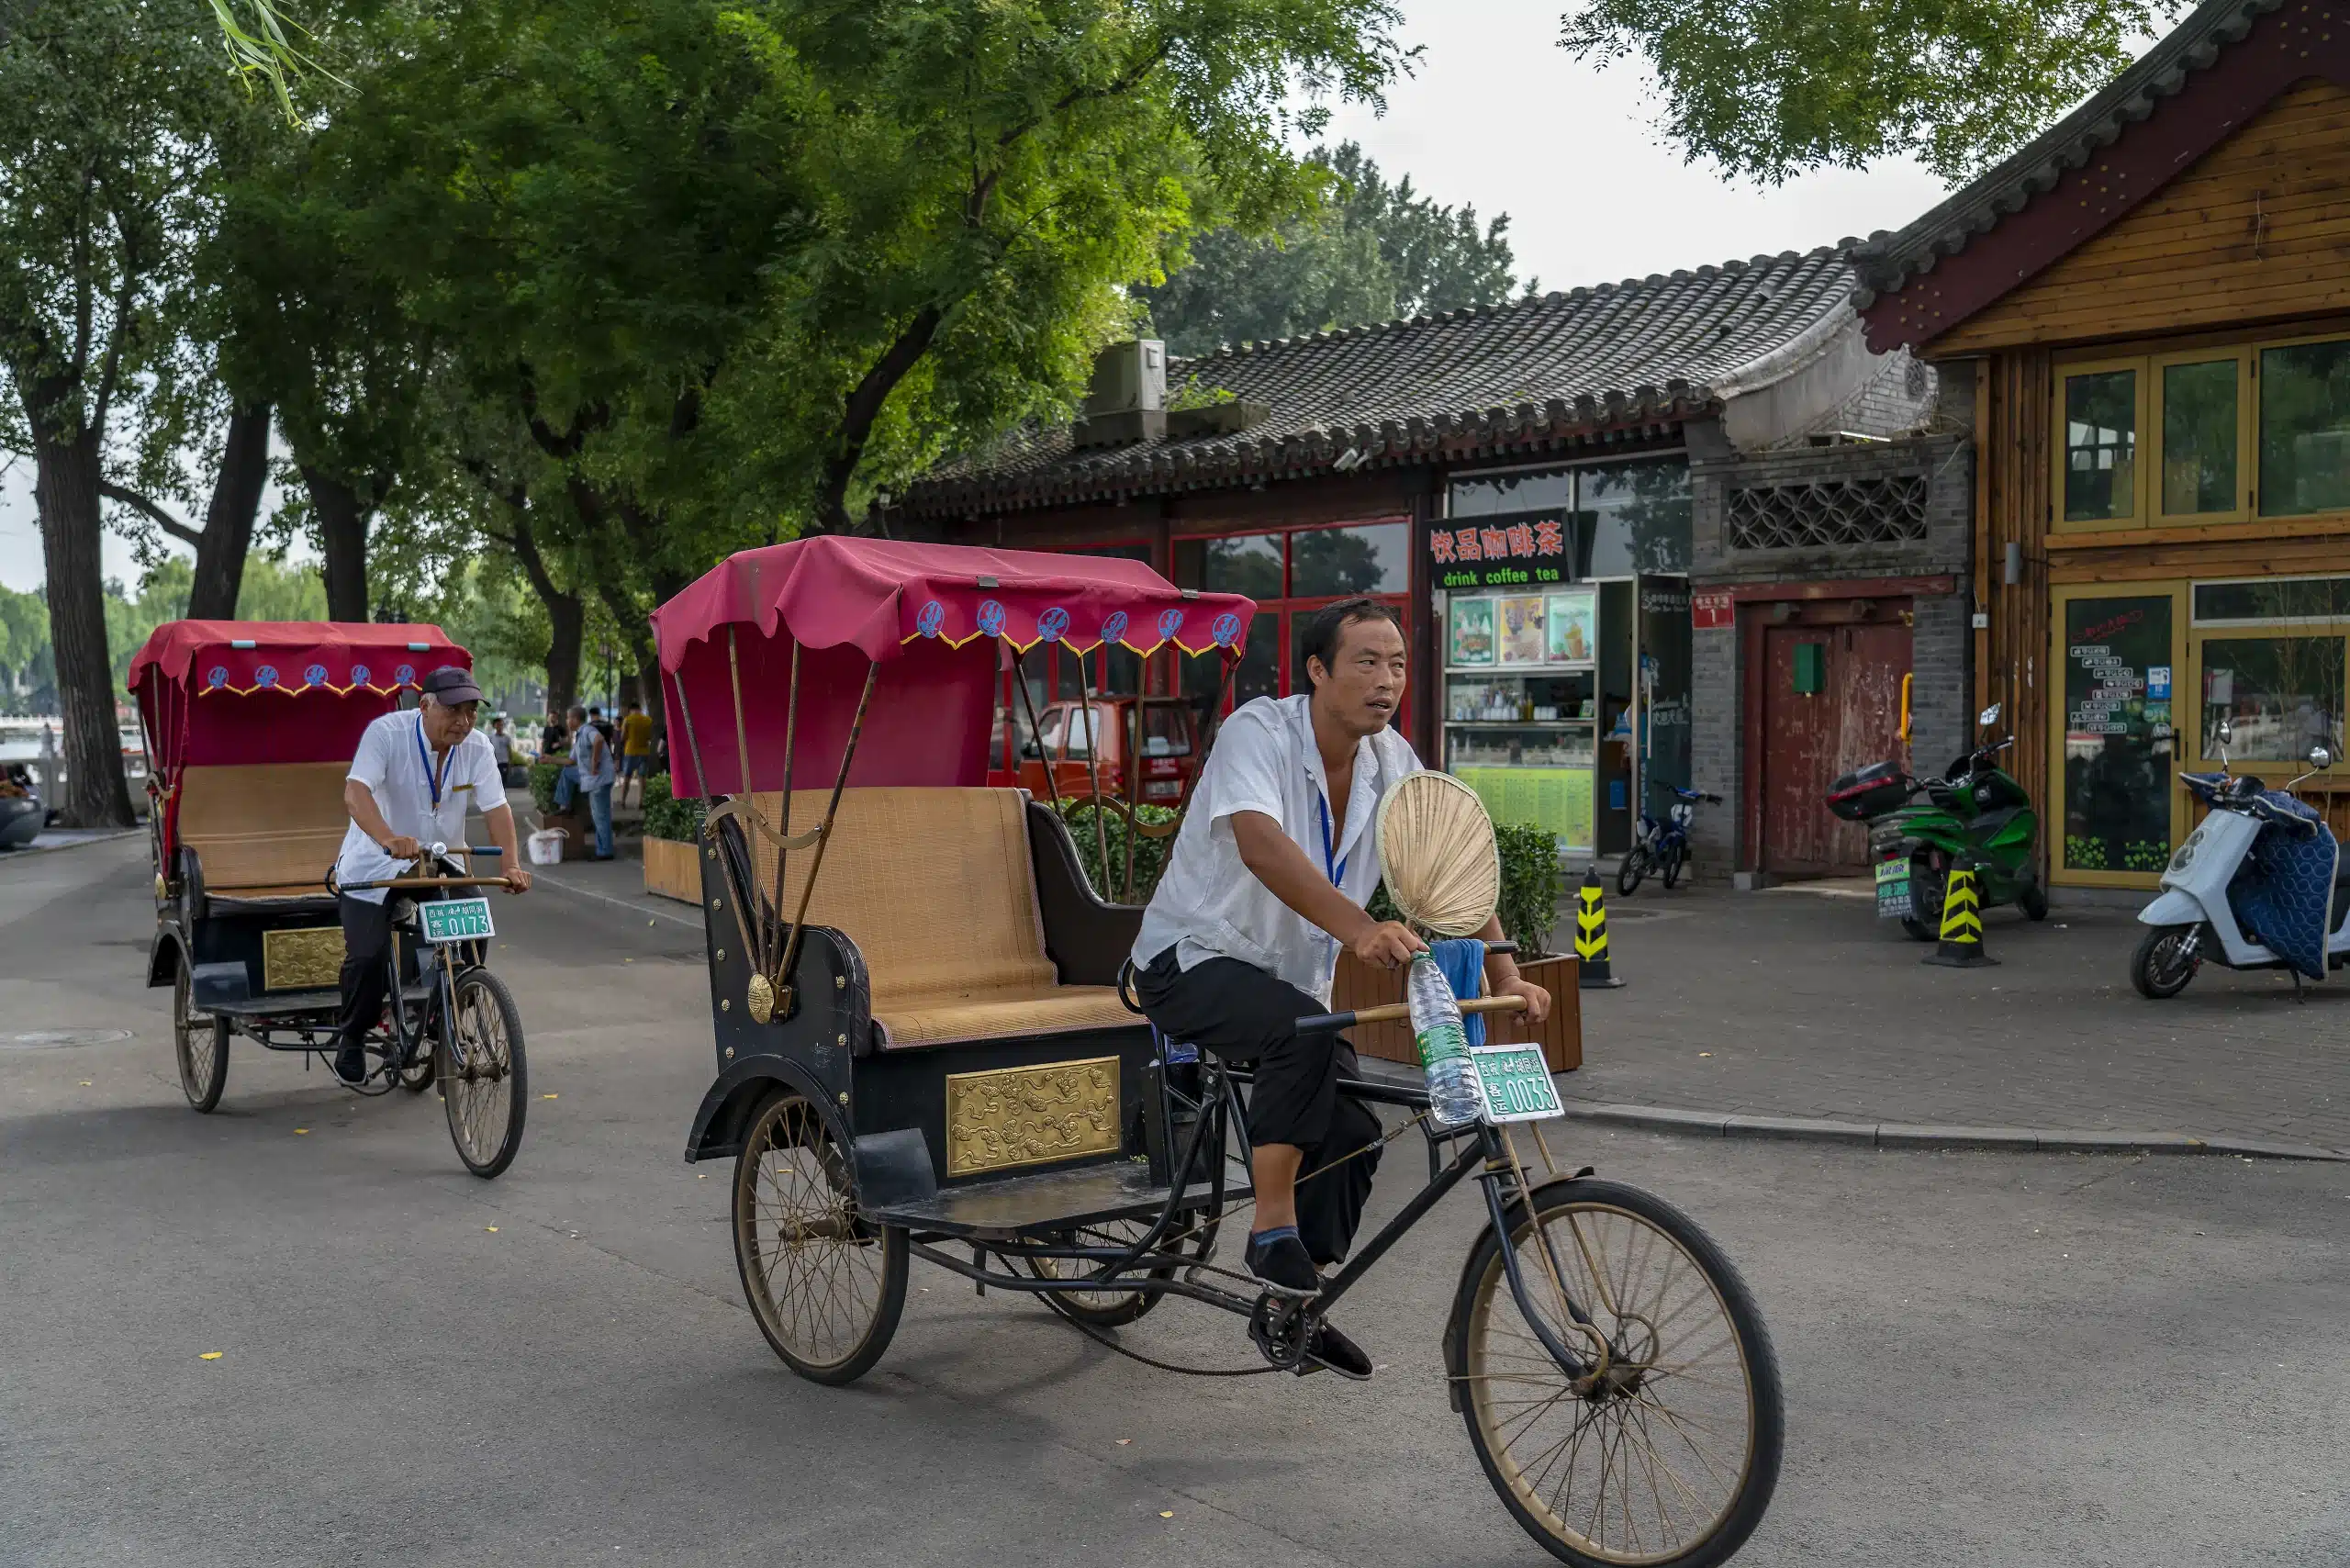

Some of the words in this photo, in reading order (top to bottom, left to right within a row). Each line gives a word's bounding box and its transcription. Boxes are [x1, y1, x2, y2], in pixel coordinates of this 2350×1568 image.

[1430, 520, 1563, 564] 饮品咖啡茶
[1444, 571, 1479, 587] drink
[1485, 567, 1528, 585] coffee
[1535, 566, 1560, 581] tea
[448, 915, 489, 935] 0173
[1485, 1081, 1510, 1114] 客运
[1505, 1075, 1557, 1113] 0033
